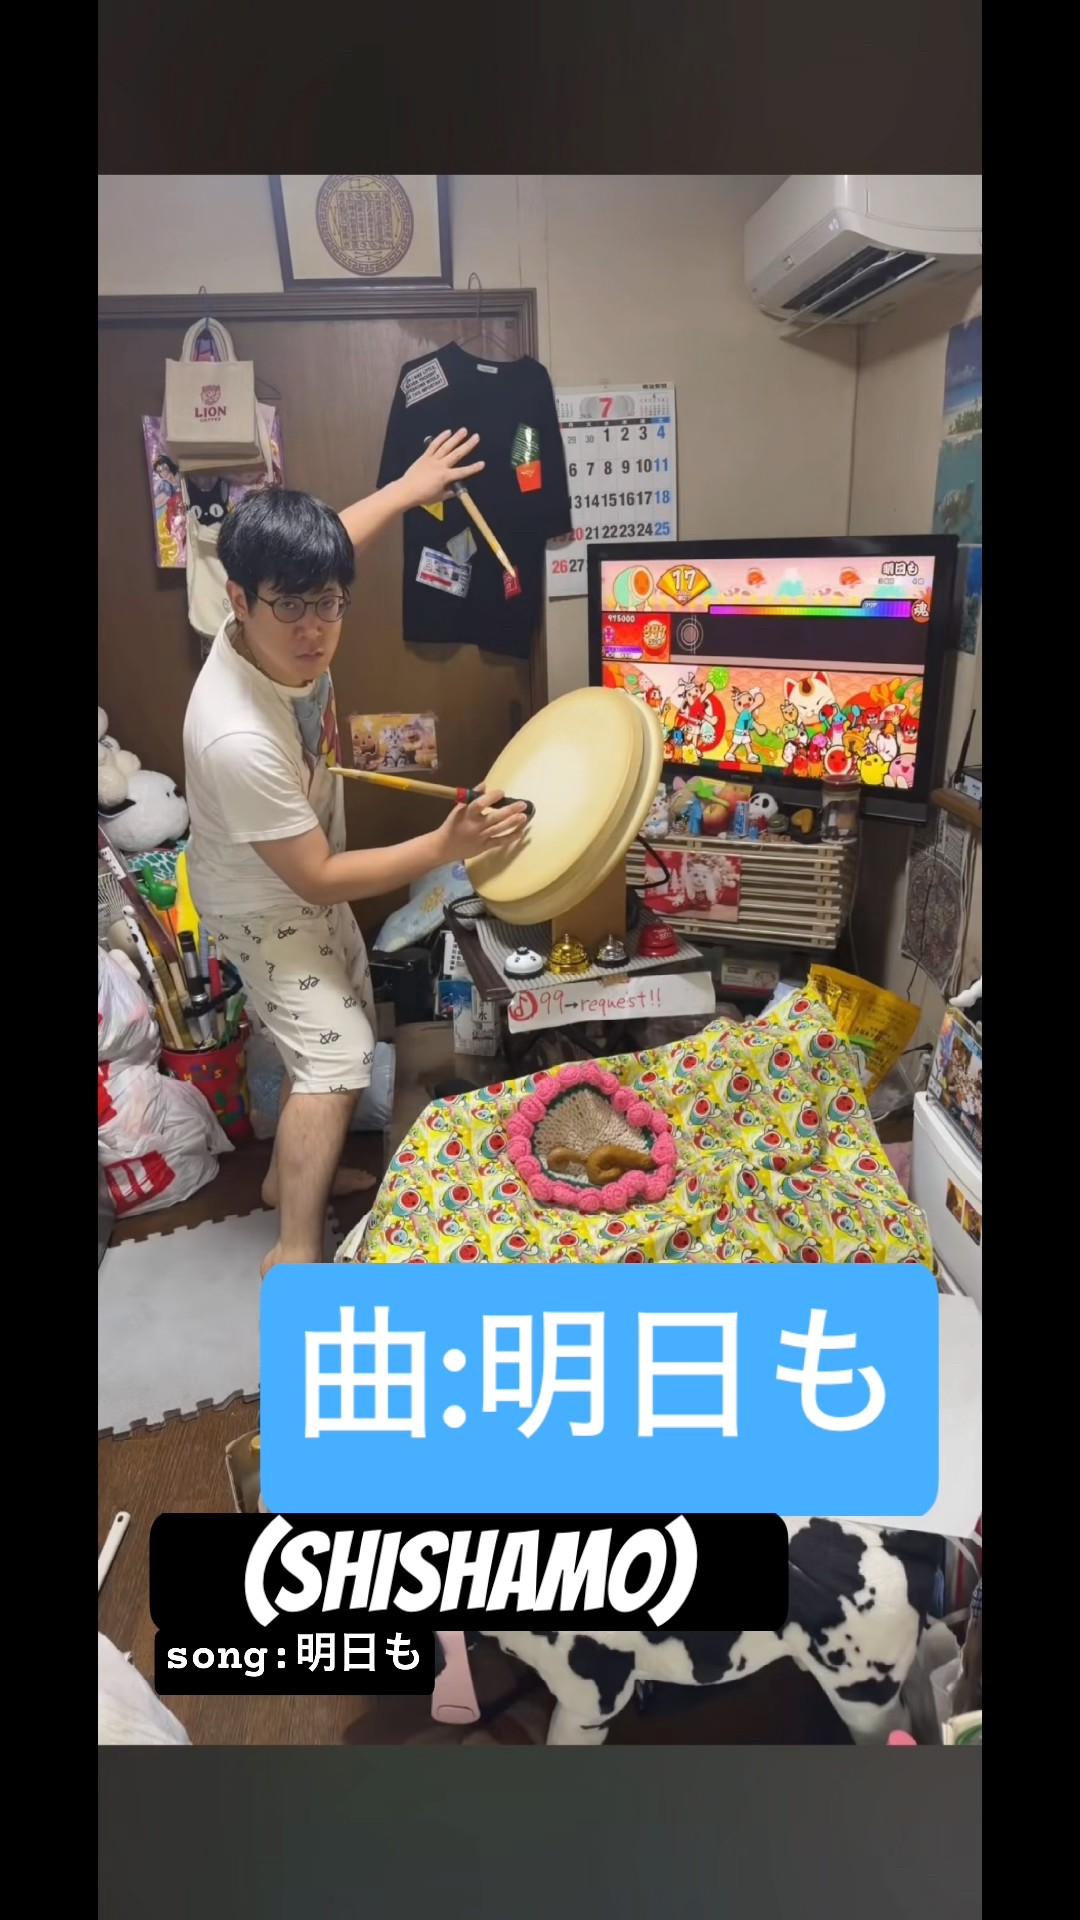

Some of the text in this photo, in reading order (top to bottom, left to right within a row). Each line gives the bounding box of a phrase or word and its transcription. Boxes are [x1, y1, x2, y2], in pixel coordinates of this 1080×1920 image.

[194, 406, 227, 418] LION
[599, 397, 613, 418] 7
[568, 425, 666, 444] 29 30 1 2 3 4
[569, 458, 668, 477] 6 7 8 9 10 11
[584, 494, 600, 508] 14
[602, 493, 617, 507] 15
[619, 492, 635, 506] 16
[637, 491, 652, 505] 17
[655, 490, 671, 504] 18
[585, 526, 599, 540] 21
[602, 525, 618, 539] 22
[620, 524, 635, 538] 23
[637, 523, 653, 537] 24
[655, 522, 671, 536] 25
[552, 559, 585, 573] 26 27
[881, 561, 919, 576] 明日も
[672, 568, 697, 591] 17
[607, 614, 636, 623] 975000
